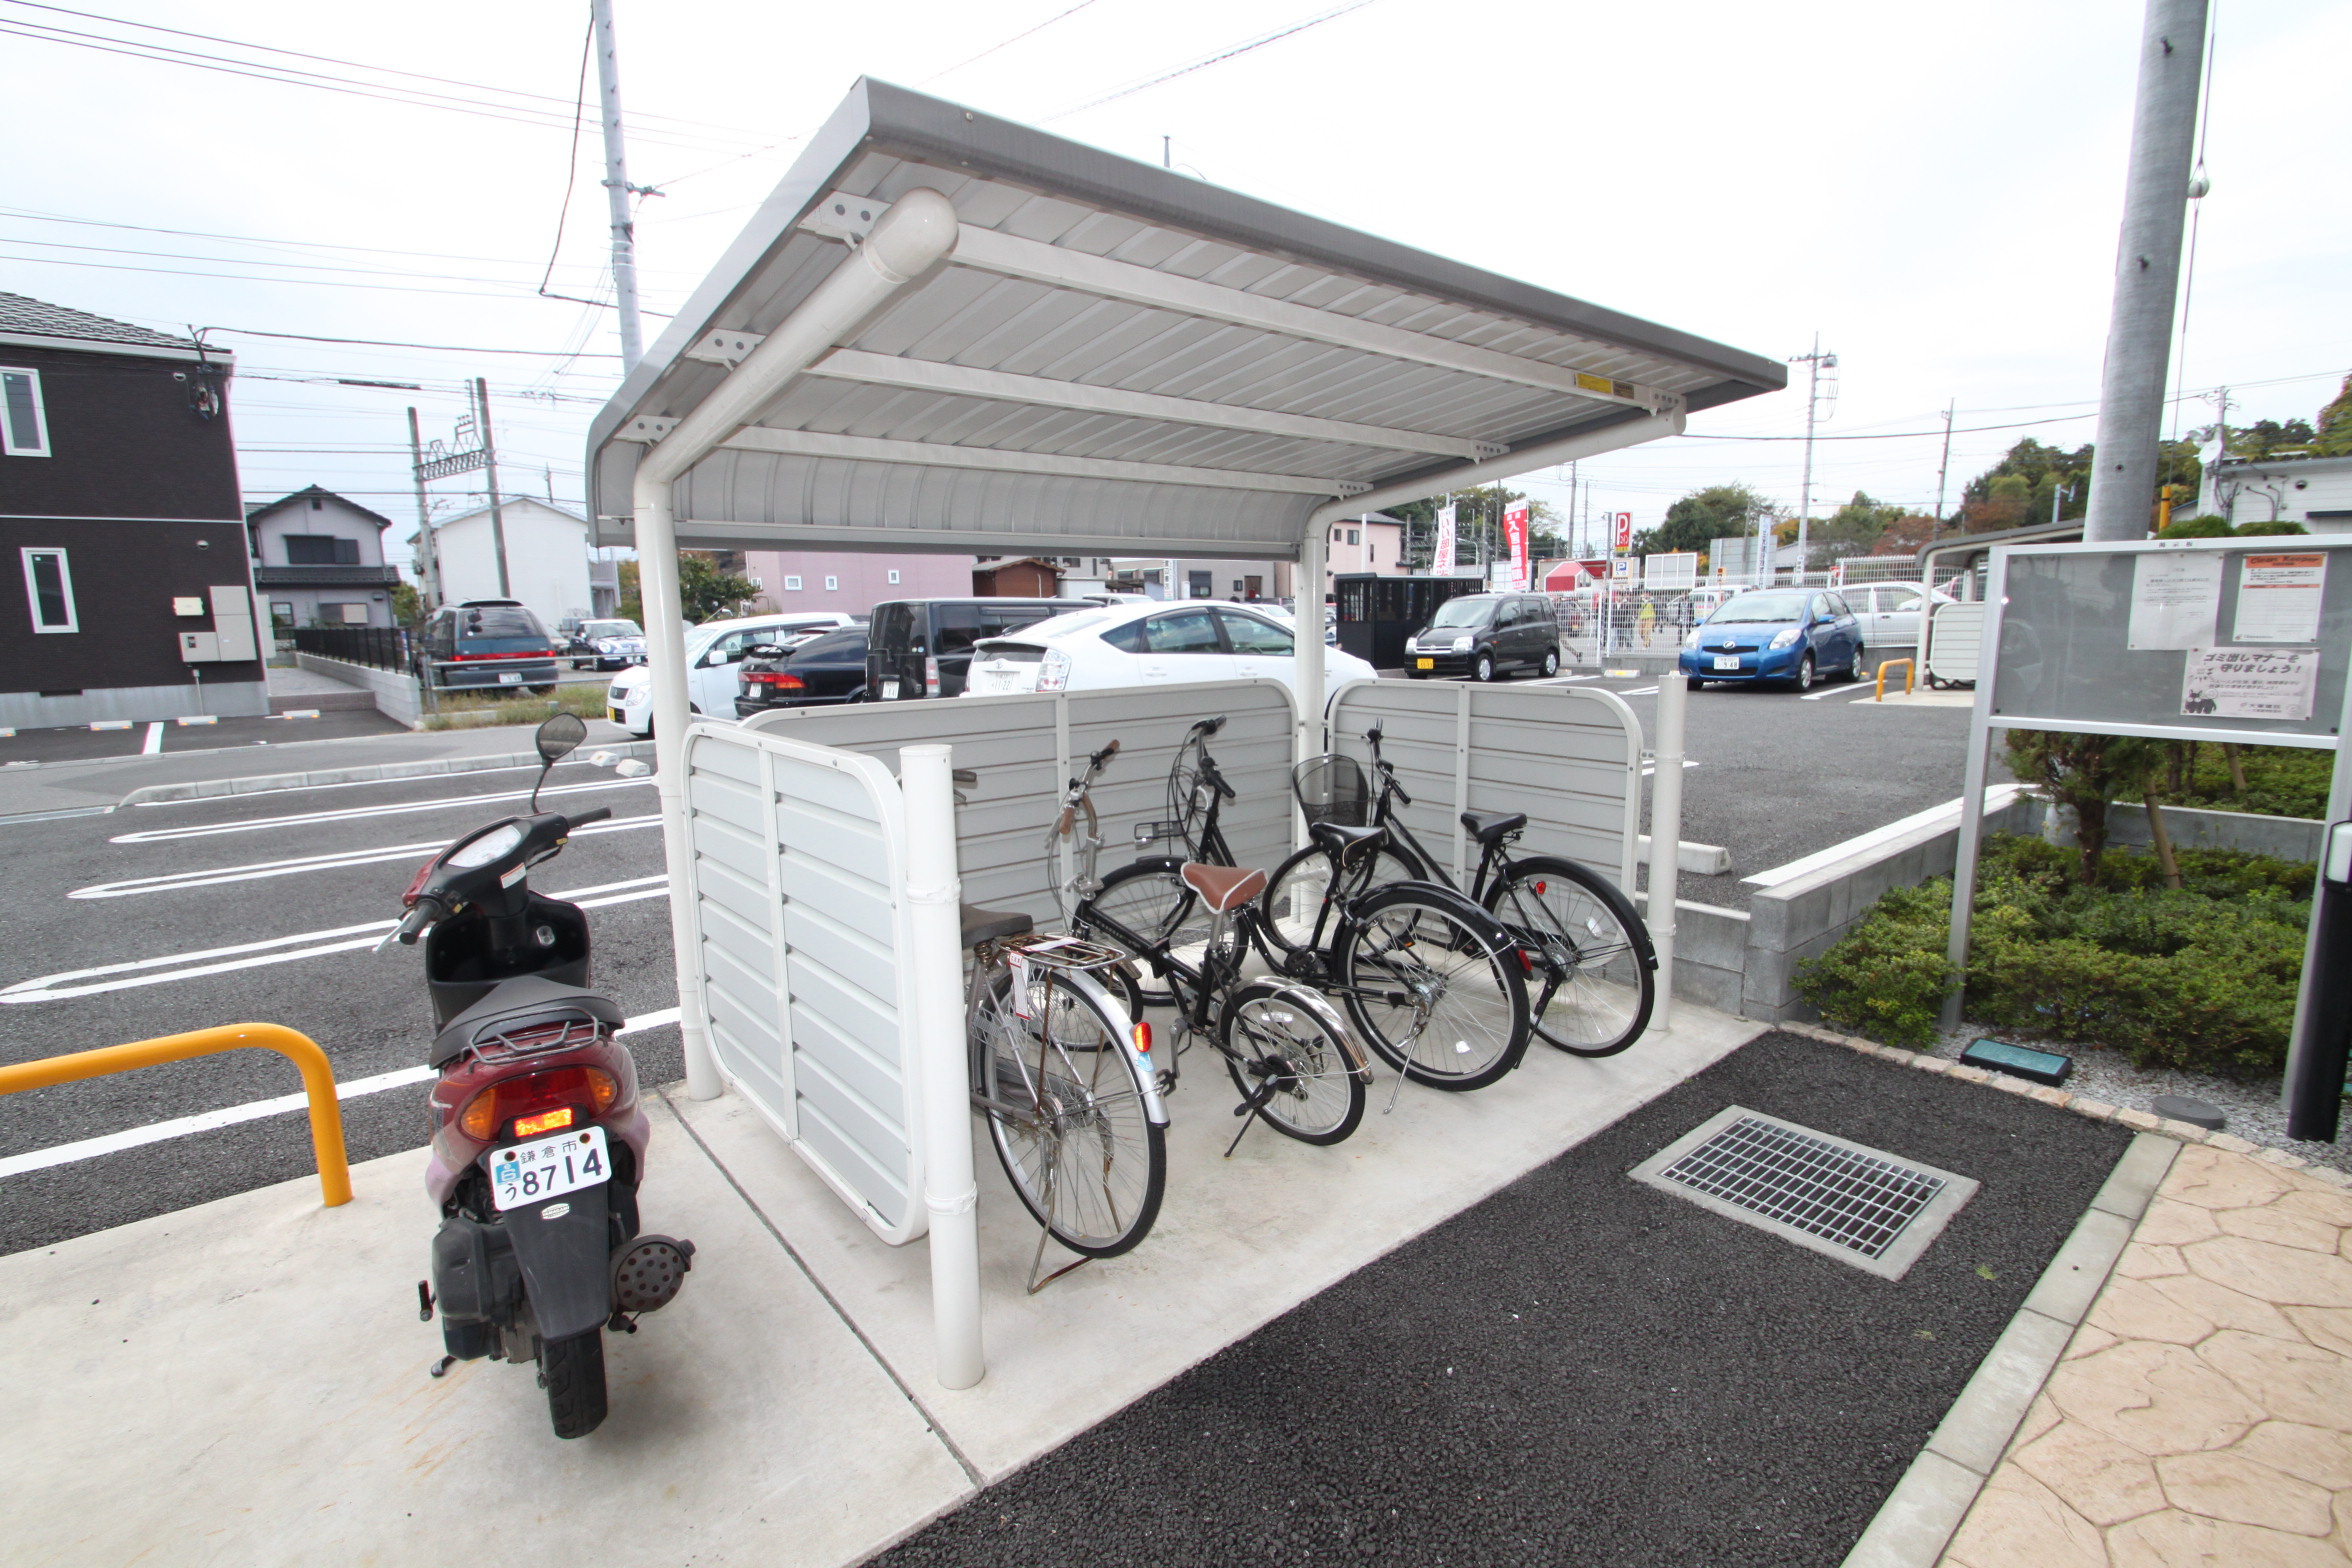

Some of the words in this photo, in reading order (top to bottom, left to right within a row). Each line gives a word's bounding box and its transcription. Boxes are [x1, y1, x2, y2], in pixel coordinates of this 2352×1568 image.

[2203, 653, 2300, 664] ゴミ出しマナーを
[520, 1139, 578, 1165] 鎌倉市
[522, 1147, 603, 1196] 8714
